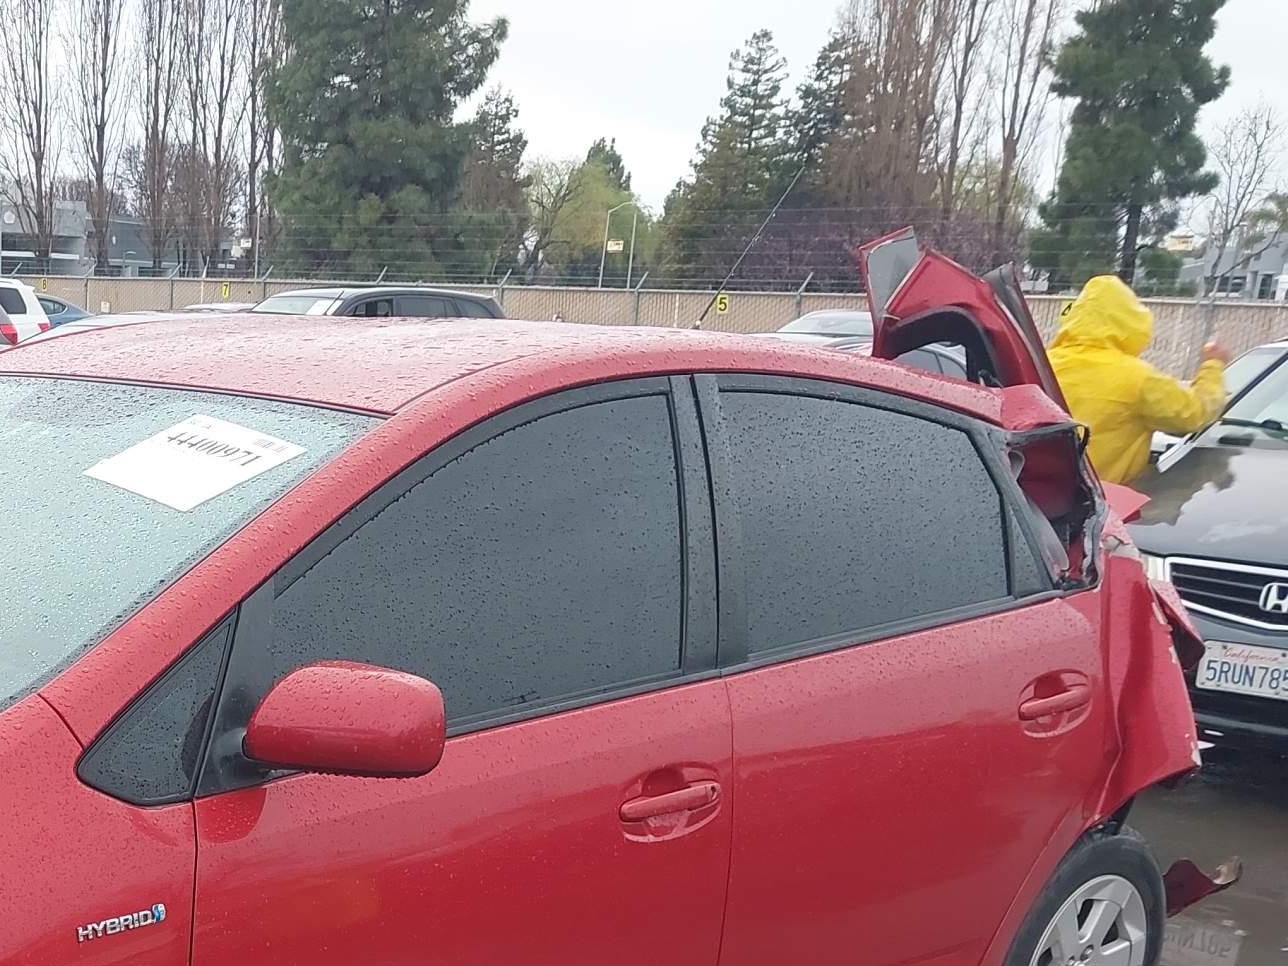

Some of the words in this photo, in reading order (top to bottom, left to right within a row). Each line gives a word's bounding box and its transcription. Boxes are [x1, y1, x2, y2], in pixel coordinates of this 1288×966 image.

[223, 283, 229, 296] 7
[718, 296, 728, 312] 5
[76, 909, 155, 942] HYBRID
